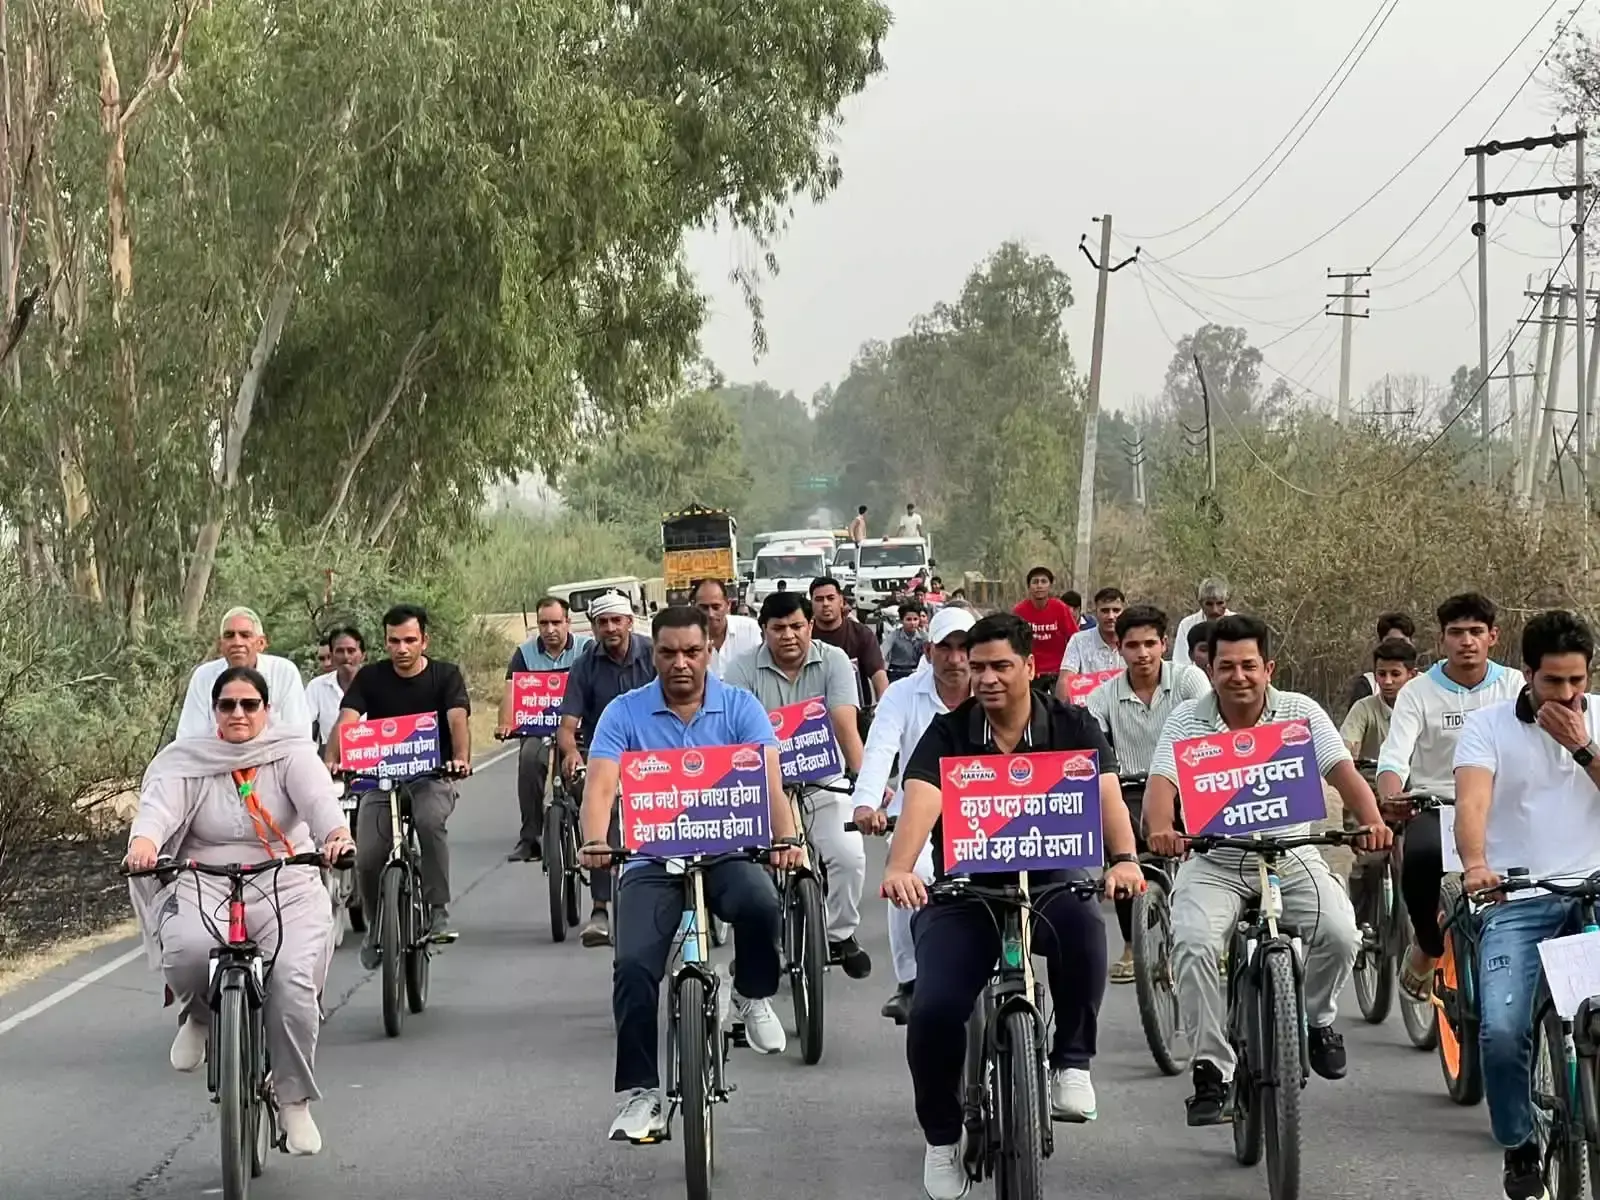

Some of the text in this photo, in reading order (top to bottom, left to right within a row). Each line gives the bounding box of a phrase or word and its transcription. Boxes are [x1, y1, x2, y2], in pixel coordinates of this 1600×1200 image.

[544, 711, 557, 726] को
[1445, 715, 1464, 726] TID
[380, 744, 394, 757] का
[413, 735, 436, 755] होगा
[794, 724, 830, 751] अपनाओ
[796, 747, 831, 773] दिखाओ
[960, 772, 995, 780] HARYANA
[1193, 756, 1305, 797] नशामुक्त
[630, 780, 761, 811] जब नशे का नाश होगा
[959, 792, 1084, 831] कुछ पल का नशा
[1223, 796, 1288, 826] भारत
[632, 818, 656, 842] देश
[657, 822, 676, 841] का
[677, 814, 722, 841] विकास
[722, 811, 754, 839] होगा
[952, 828, 988, 861] सारी
[990, 836, 1017, 864] उम्र
[1018, 826, 1042, 858] की
[1044, 833, 1083, 858] सजा
